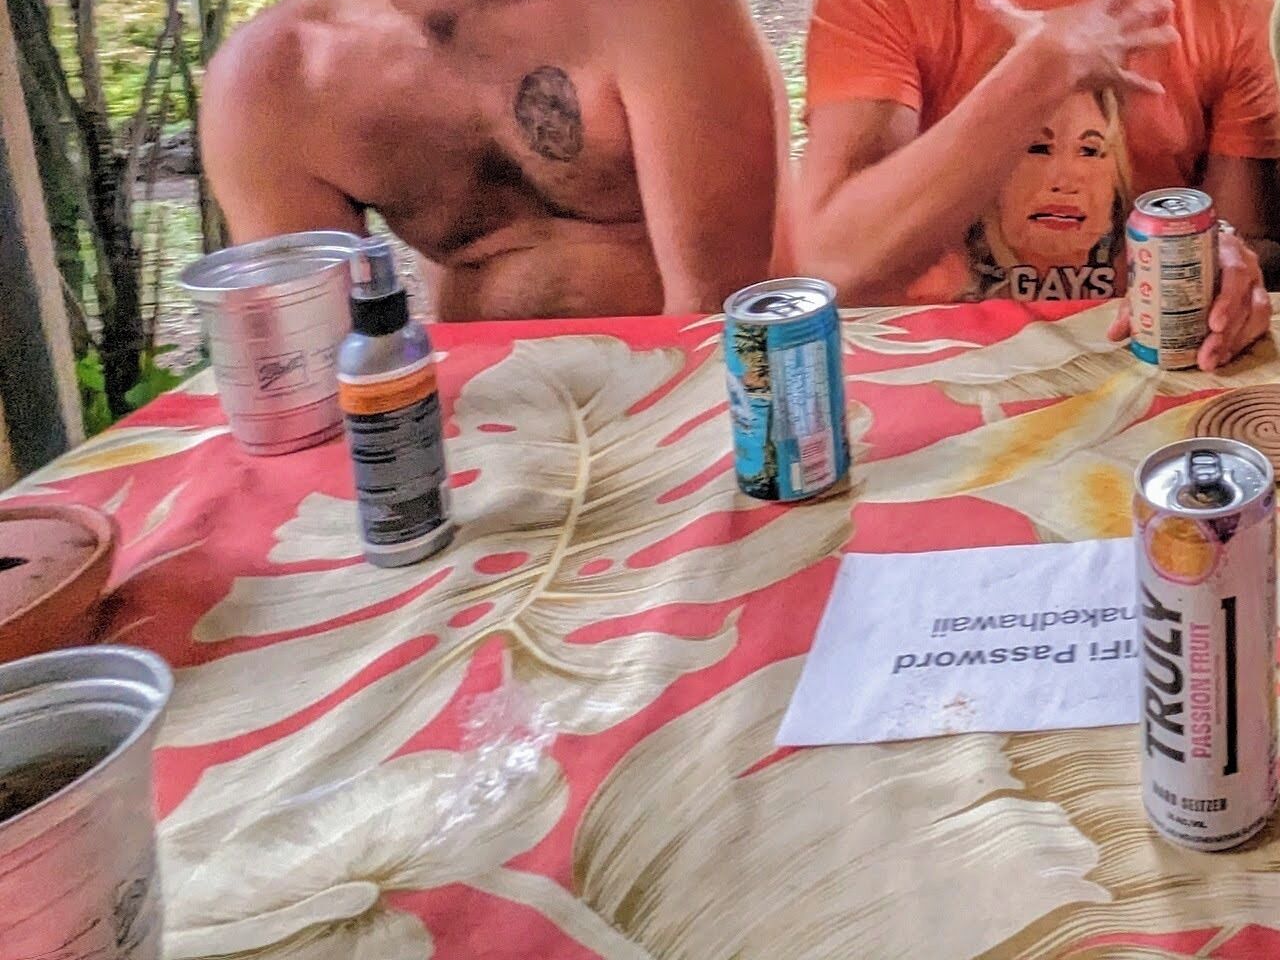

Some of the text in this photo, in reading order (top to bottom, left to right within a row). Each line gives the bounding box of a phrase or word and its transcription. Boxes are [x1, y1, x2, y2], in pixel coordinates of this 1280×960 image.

[1010, 265, 1115, 301] GAYS
[892, 639, 1140, 674] iFi Password
[1140, 583, 1186, 764] TRULY
[1188, 621, 1212, 759] PASSION FRUIT
[1181, 797, 1228, 813] SELTZER
